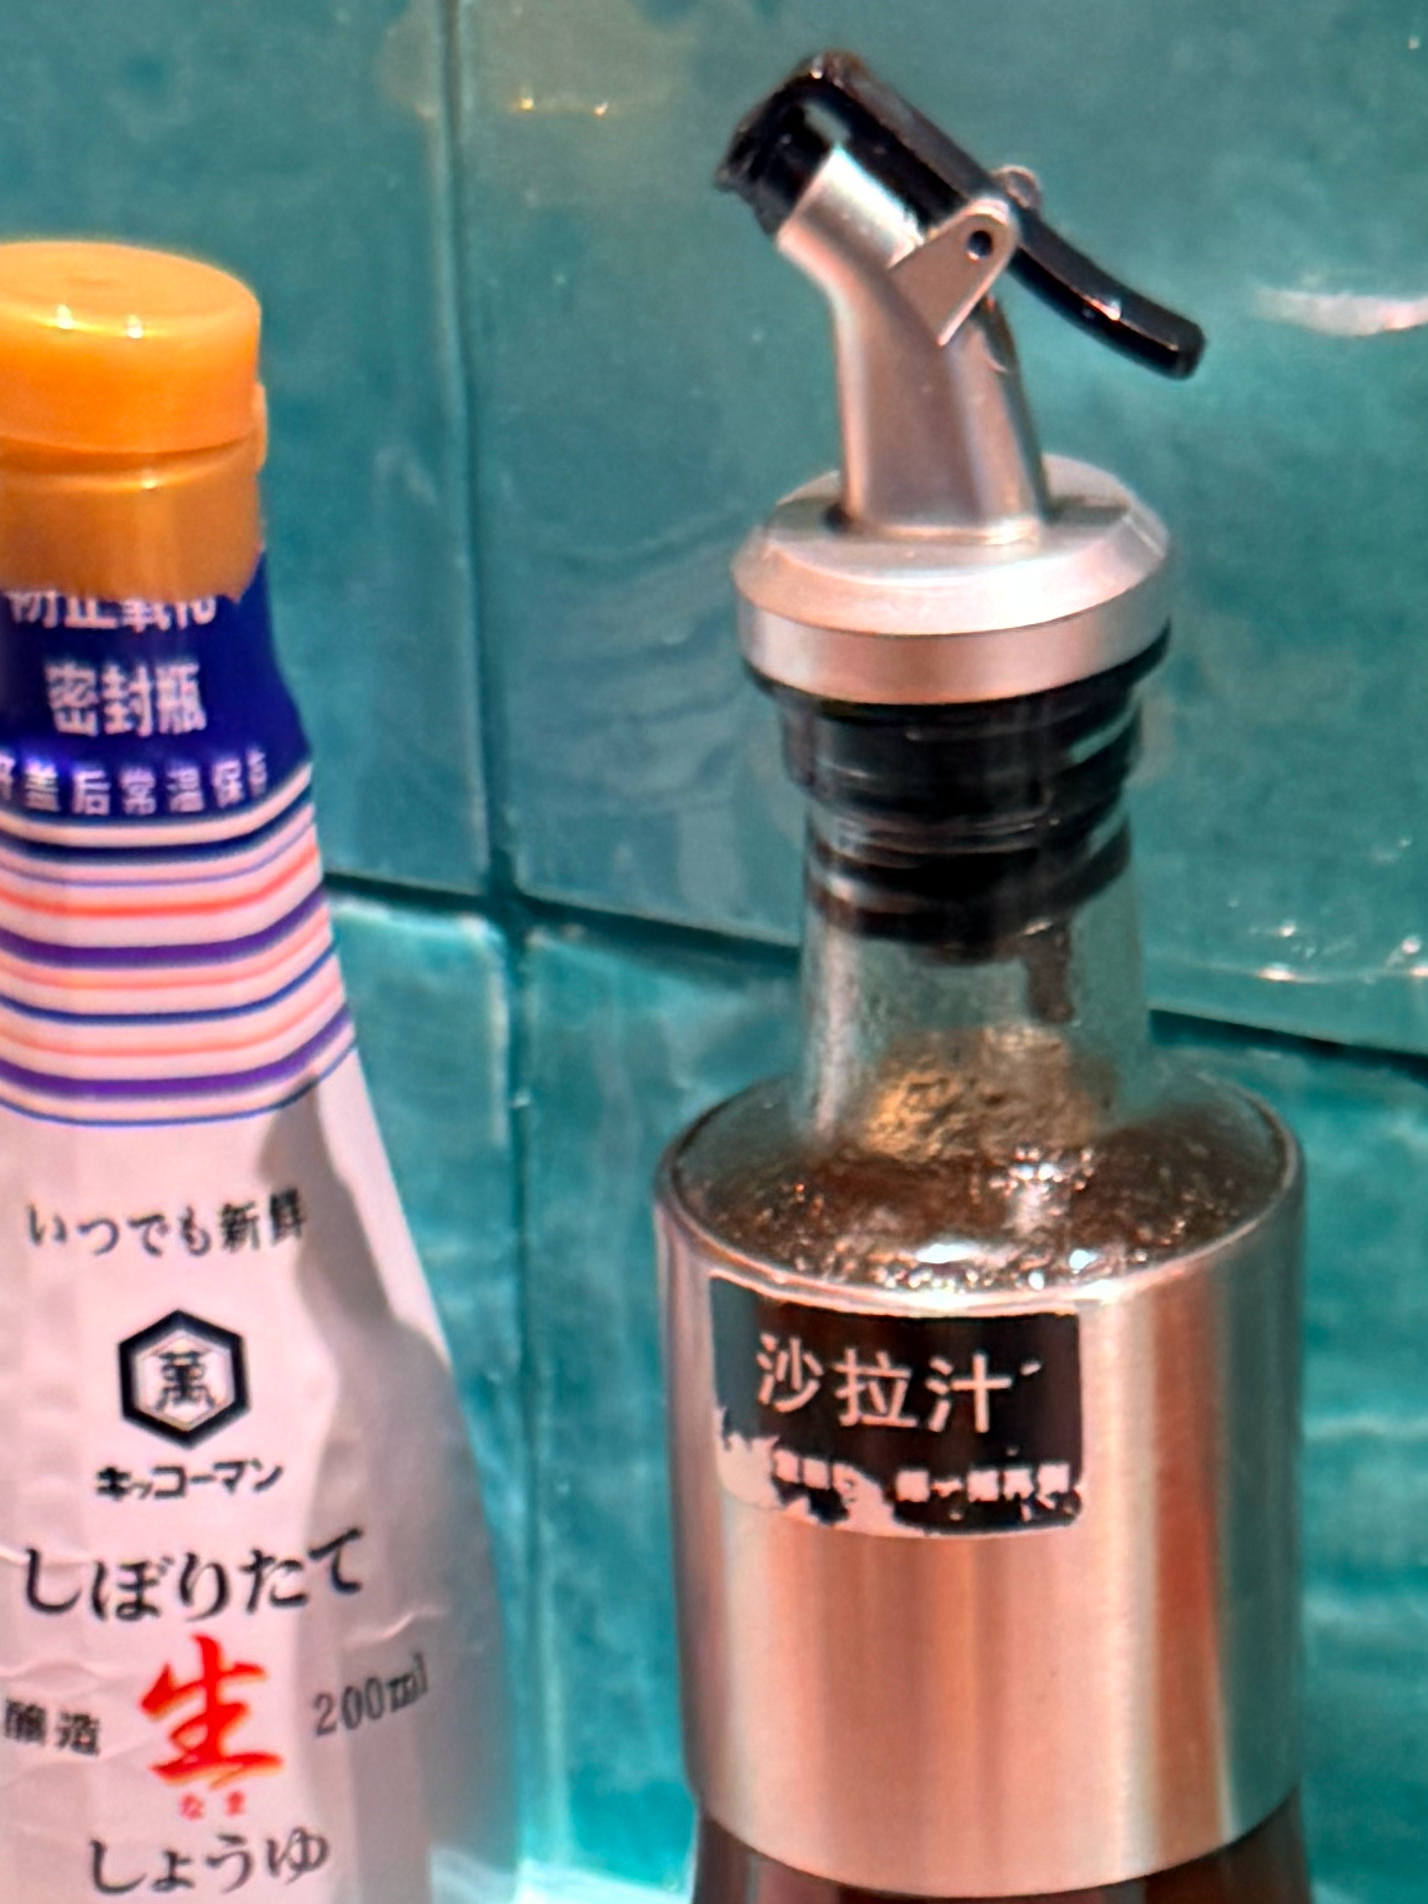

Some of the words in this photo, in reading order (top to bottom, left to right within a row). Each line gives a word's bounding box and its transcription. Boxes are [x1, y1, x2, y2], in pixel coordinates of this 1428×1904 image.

[43, 660, 208, 737] 密封瓶
[756, 1334, 1013, 1433] 沙拉汁
[96, 1457, 284, 1501] キッコーマン
[24, 1527, 364, 1624] しぼりたて
[140, 1633, 285, 1789] 生
[312, 1654, 430, 1739] 200ml
[90, 1827, 329, 1896] しょうゆ
